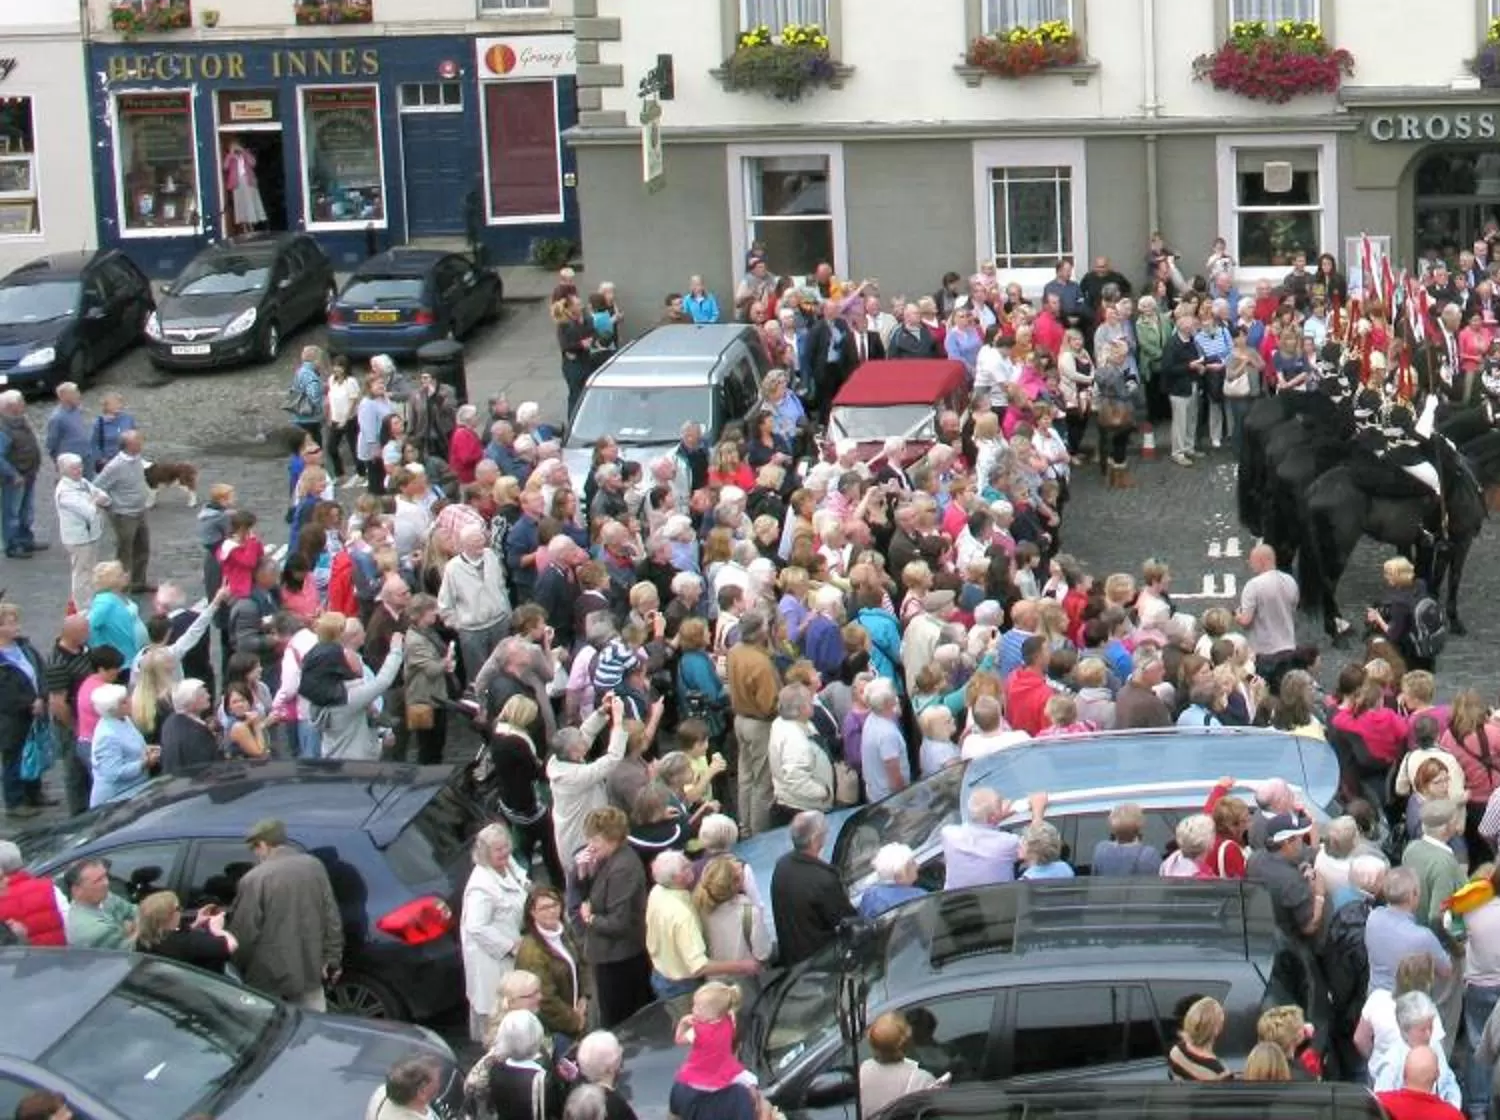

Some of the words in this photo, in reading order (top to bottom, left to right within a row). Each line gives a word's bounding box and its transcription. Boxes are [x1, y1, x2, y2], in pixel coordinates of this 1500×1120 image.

[108, 52, 246, 81] HECTOR
[272, 48, 380, 79] INNES
[1371, 112, 1496, 141] CROSS
